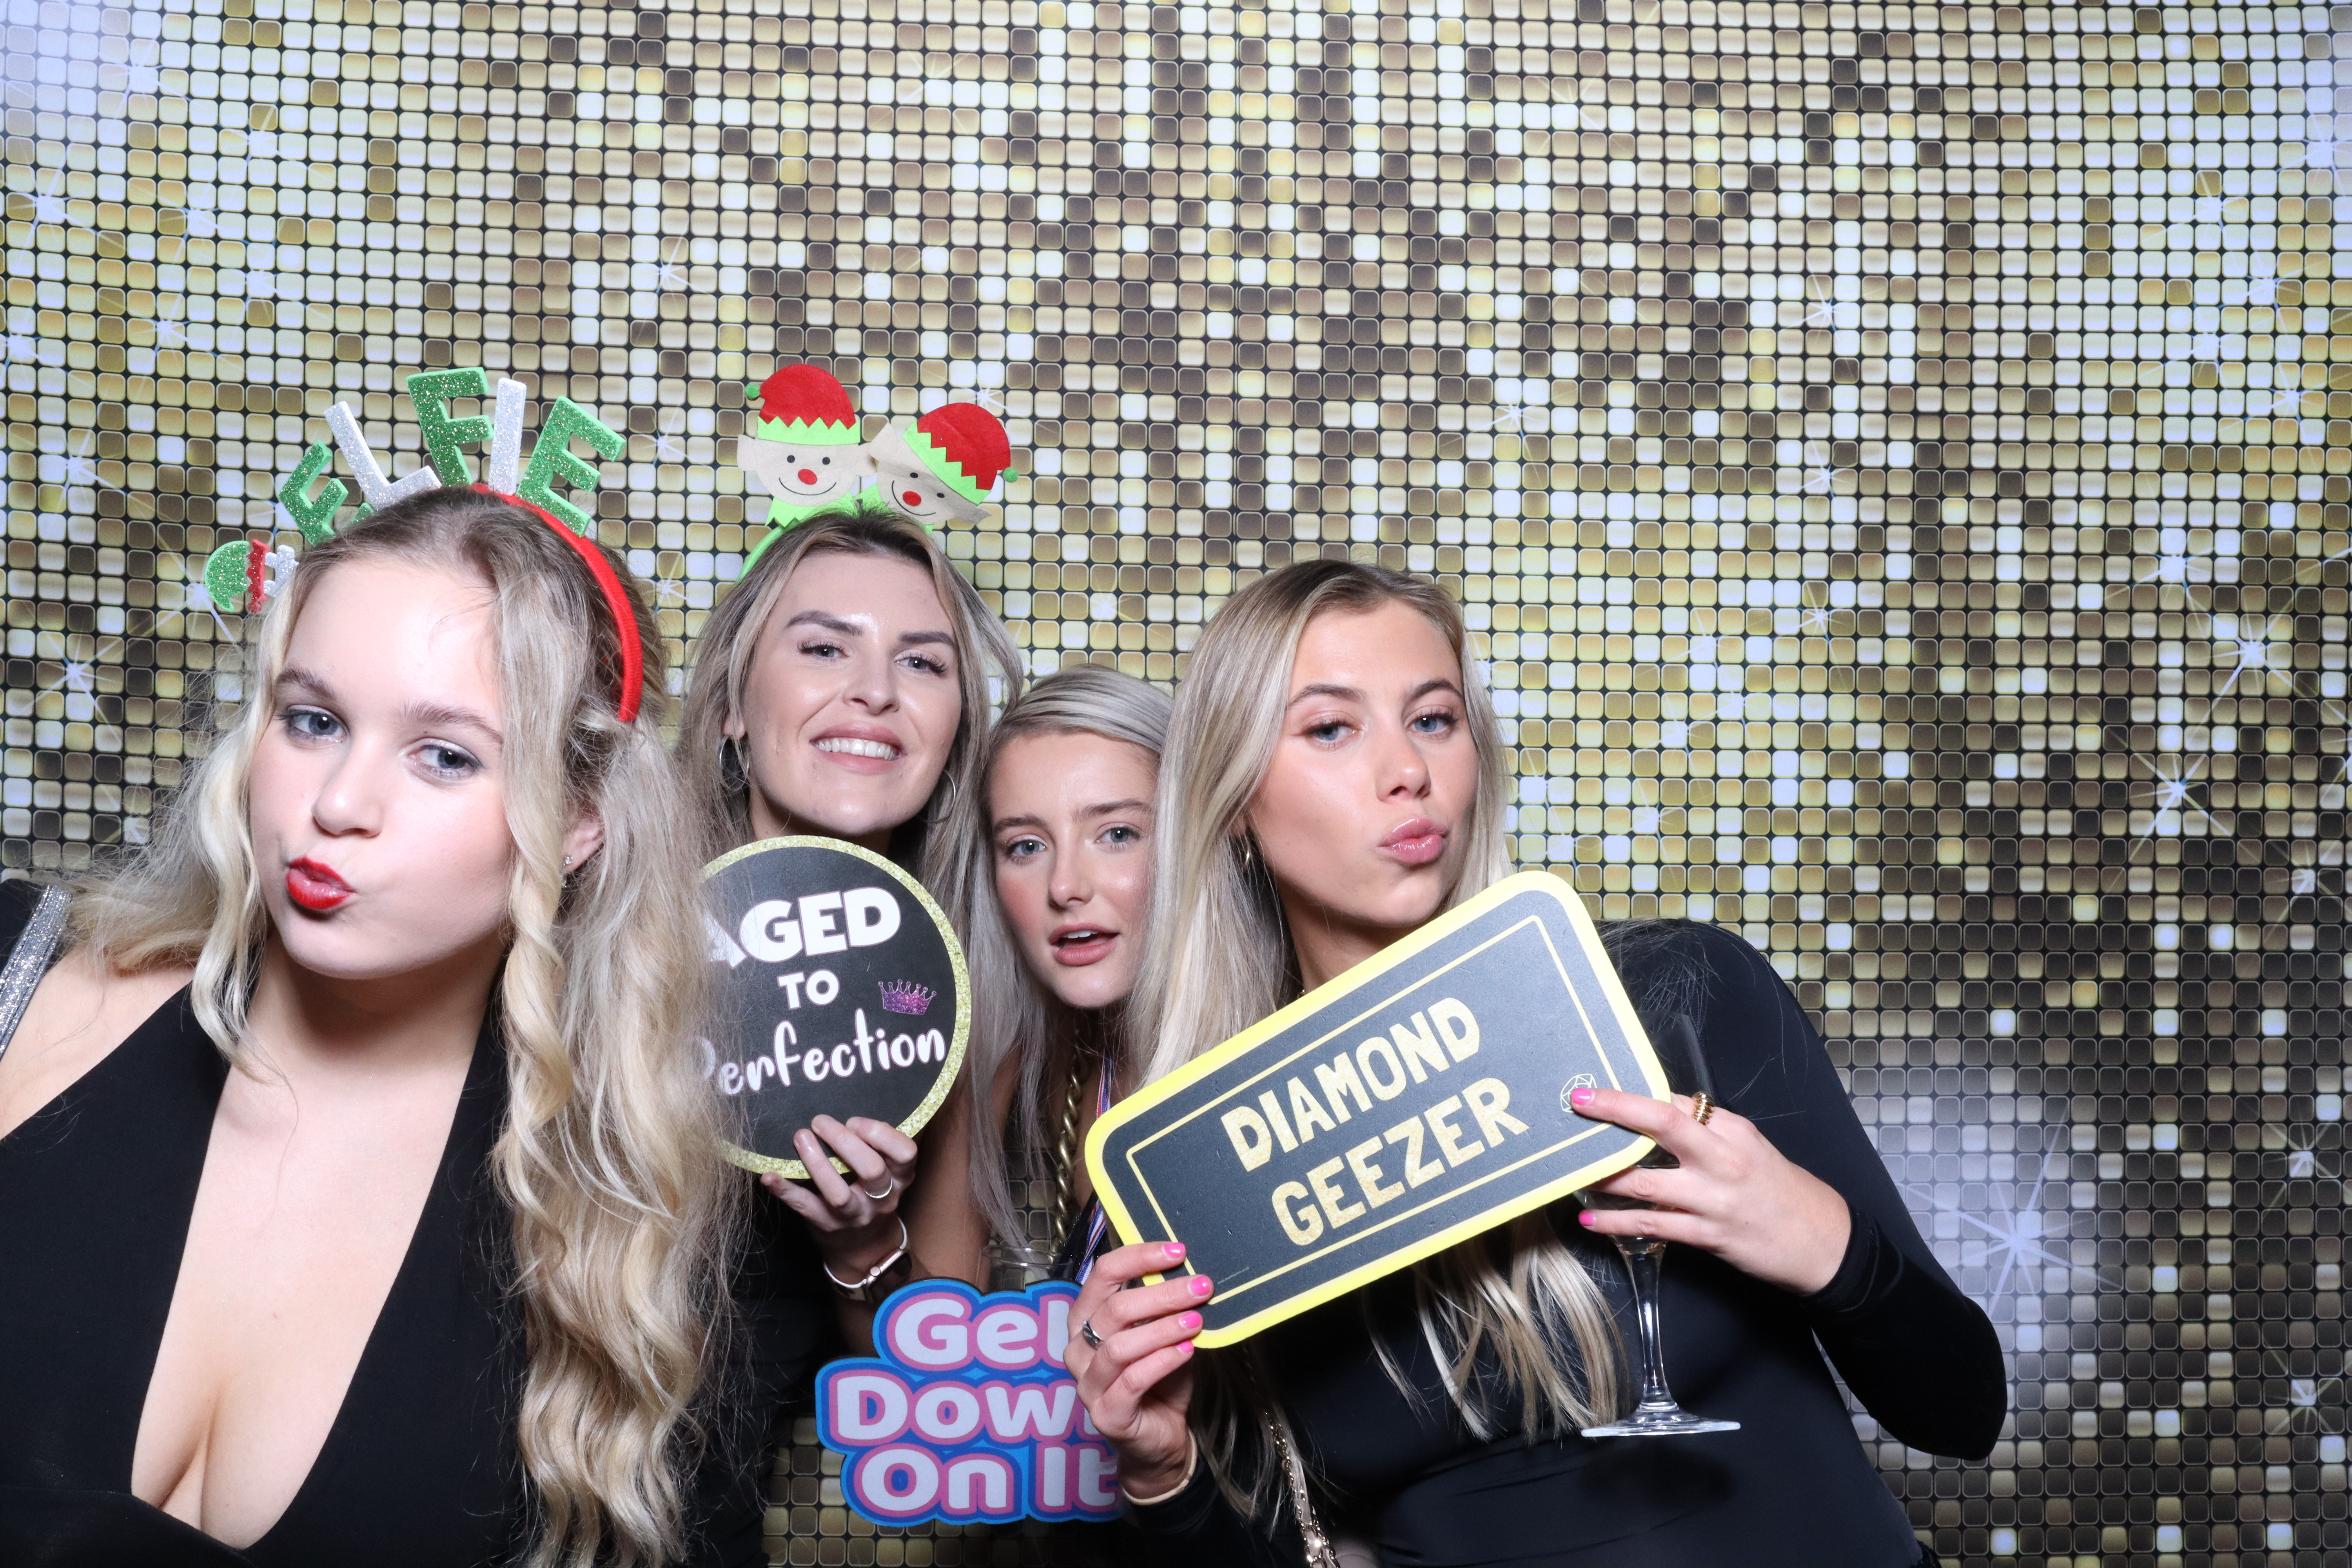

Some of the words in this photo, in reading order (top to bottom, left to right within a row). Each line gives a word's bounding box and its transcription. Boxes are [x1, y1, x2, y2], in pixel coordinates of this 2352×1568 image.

[279, 367, 626, 545] ELFIE
[777, 969, 840, 1010] TO
[1220, 998, 1480, 1172] DIAMOND
[1271, 1078, 1530, 1246] GEEZER
[837, 1375, 1099, 1440] Dow
[862, 1448, 1007, 1511] On
[1044, 1446, 1118, 1507] It
